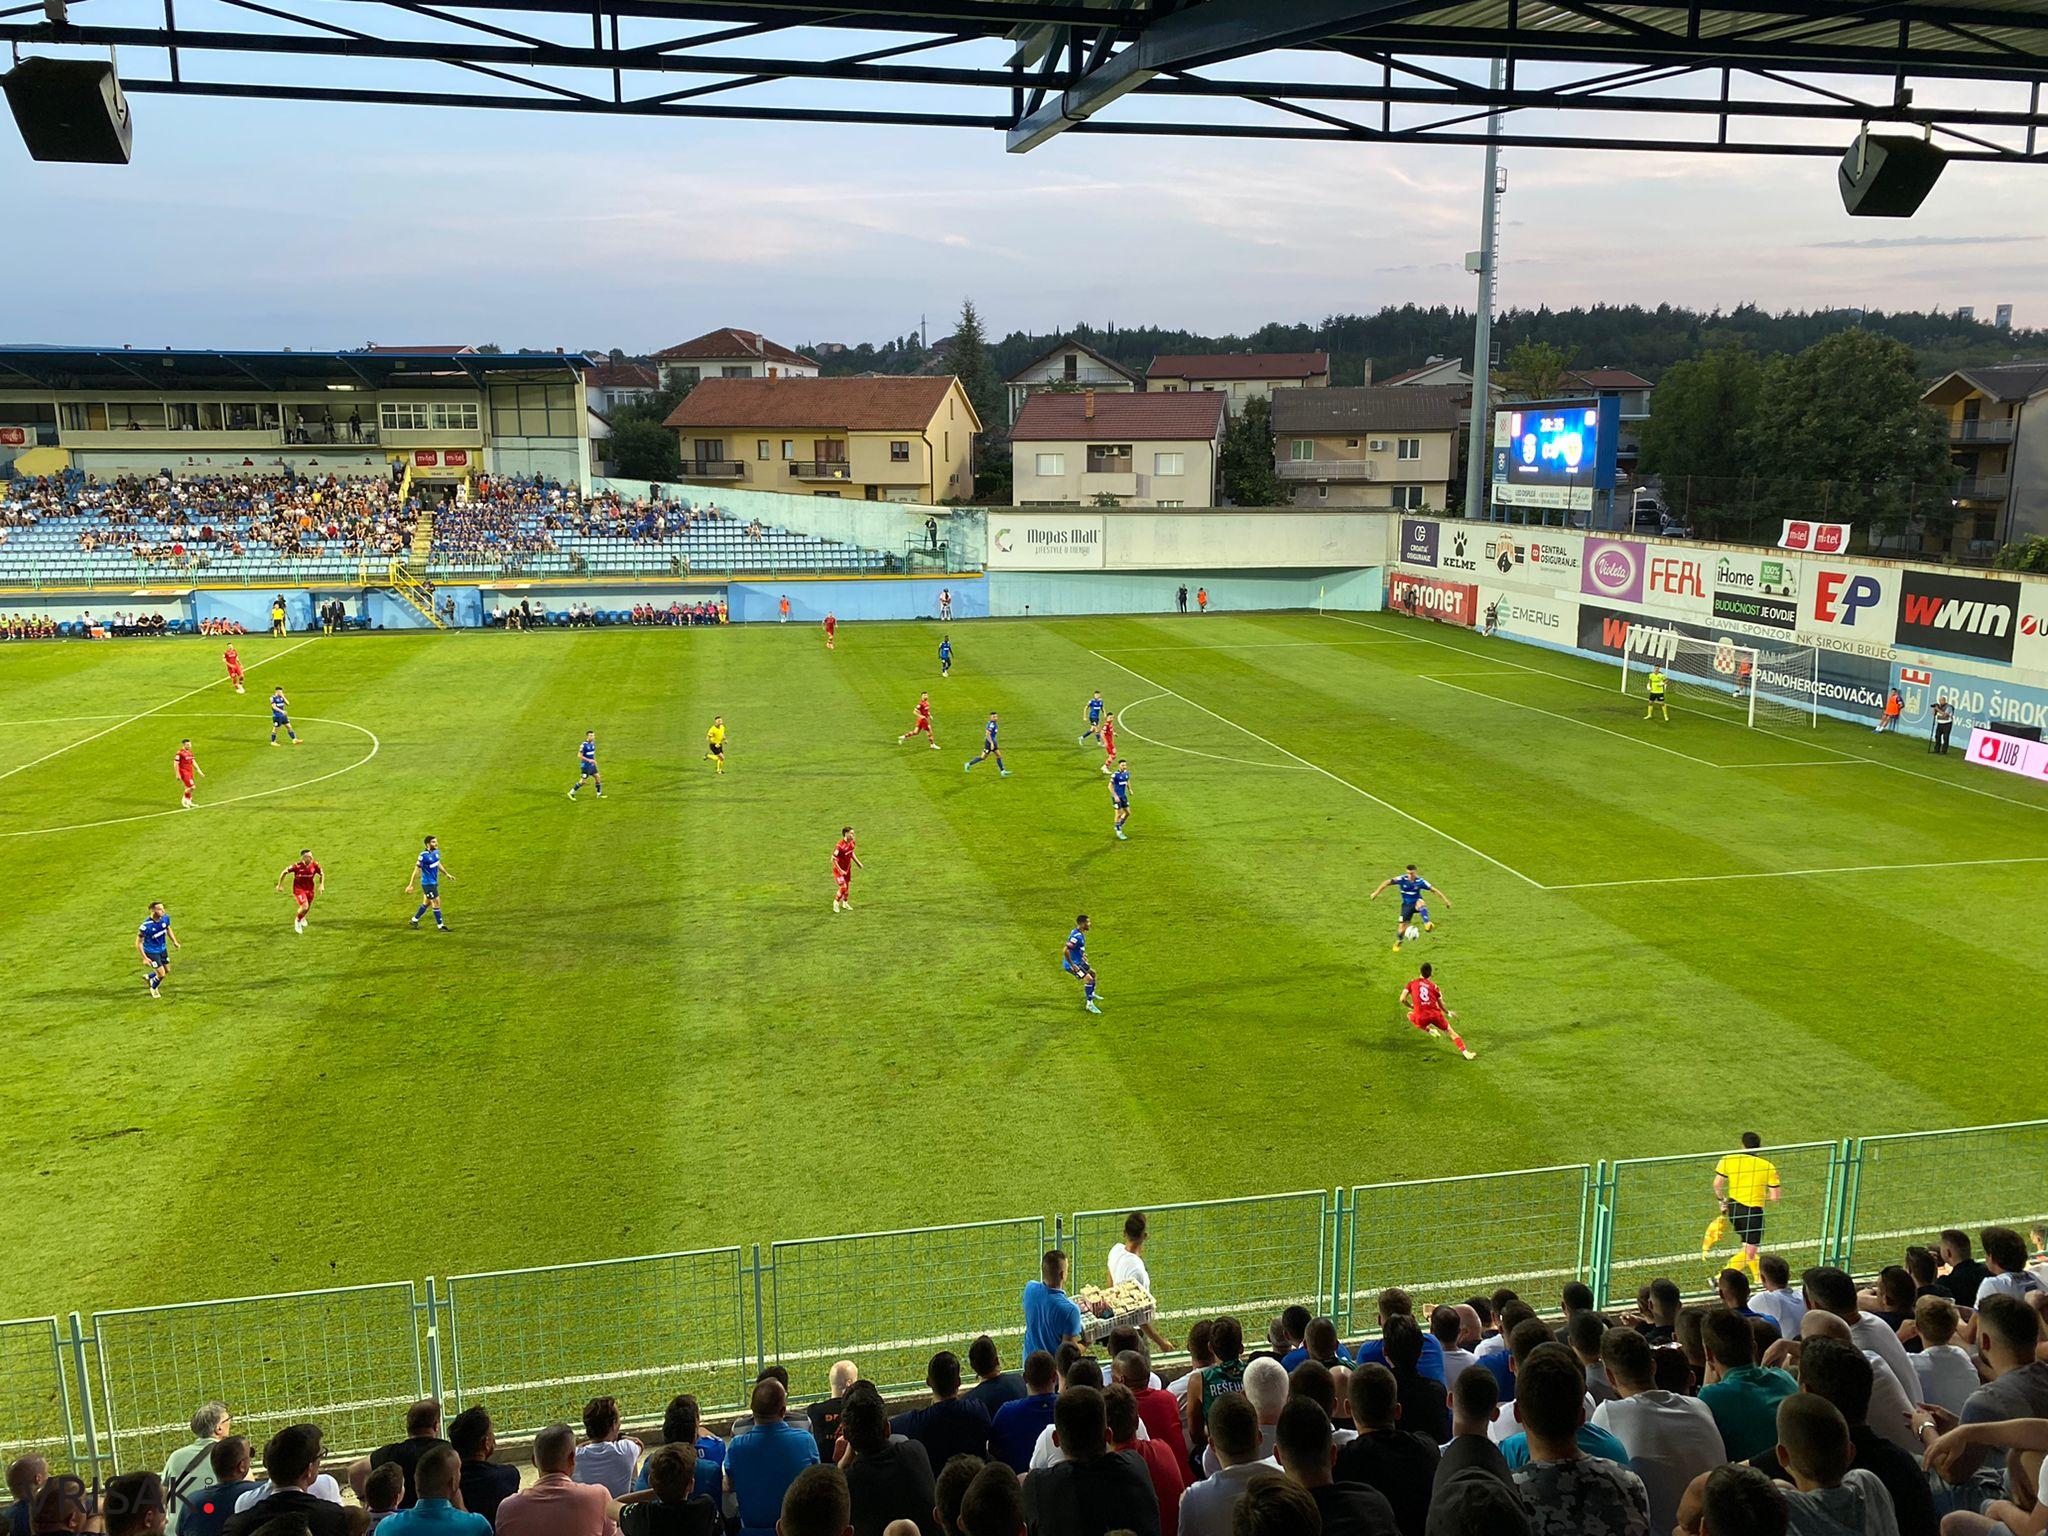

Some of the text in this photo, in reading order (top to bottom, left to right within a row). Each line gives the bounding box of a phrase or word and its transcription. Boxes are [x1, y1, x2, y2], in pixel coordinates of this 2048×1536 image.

[1028, 529, 1097, 545] Mepas Mall
[1541, 544, 1567, 556] CENTRAL
[1443, 557, 1476, 571] KELME
[1540, 554, 1577, 568] OSIGURANJE
[1598, 558, 1626, 578] Violeta
[1717, 565, 1754, 586] iHome
[1512, 606, 1560, 628] EMERUS
[1714, 599, 1761, 616] BUDUĆNOST
[1769, 607, 1795, 622] OVDJE
[1704, 617, 1792, 641] GLAVNI SPONZOR
[1796, 634, 1813, 646] NK
[1857, 643, 1898, 660] BRIJEG
[1752, 668, 1884, 708] PADNOHERCEGOVAČKA
[1936, 685, 1985, 714] GRAD
[1997, 741, 2020, 766] JUB
[1419, 985, 1430, 1002] 8
